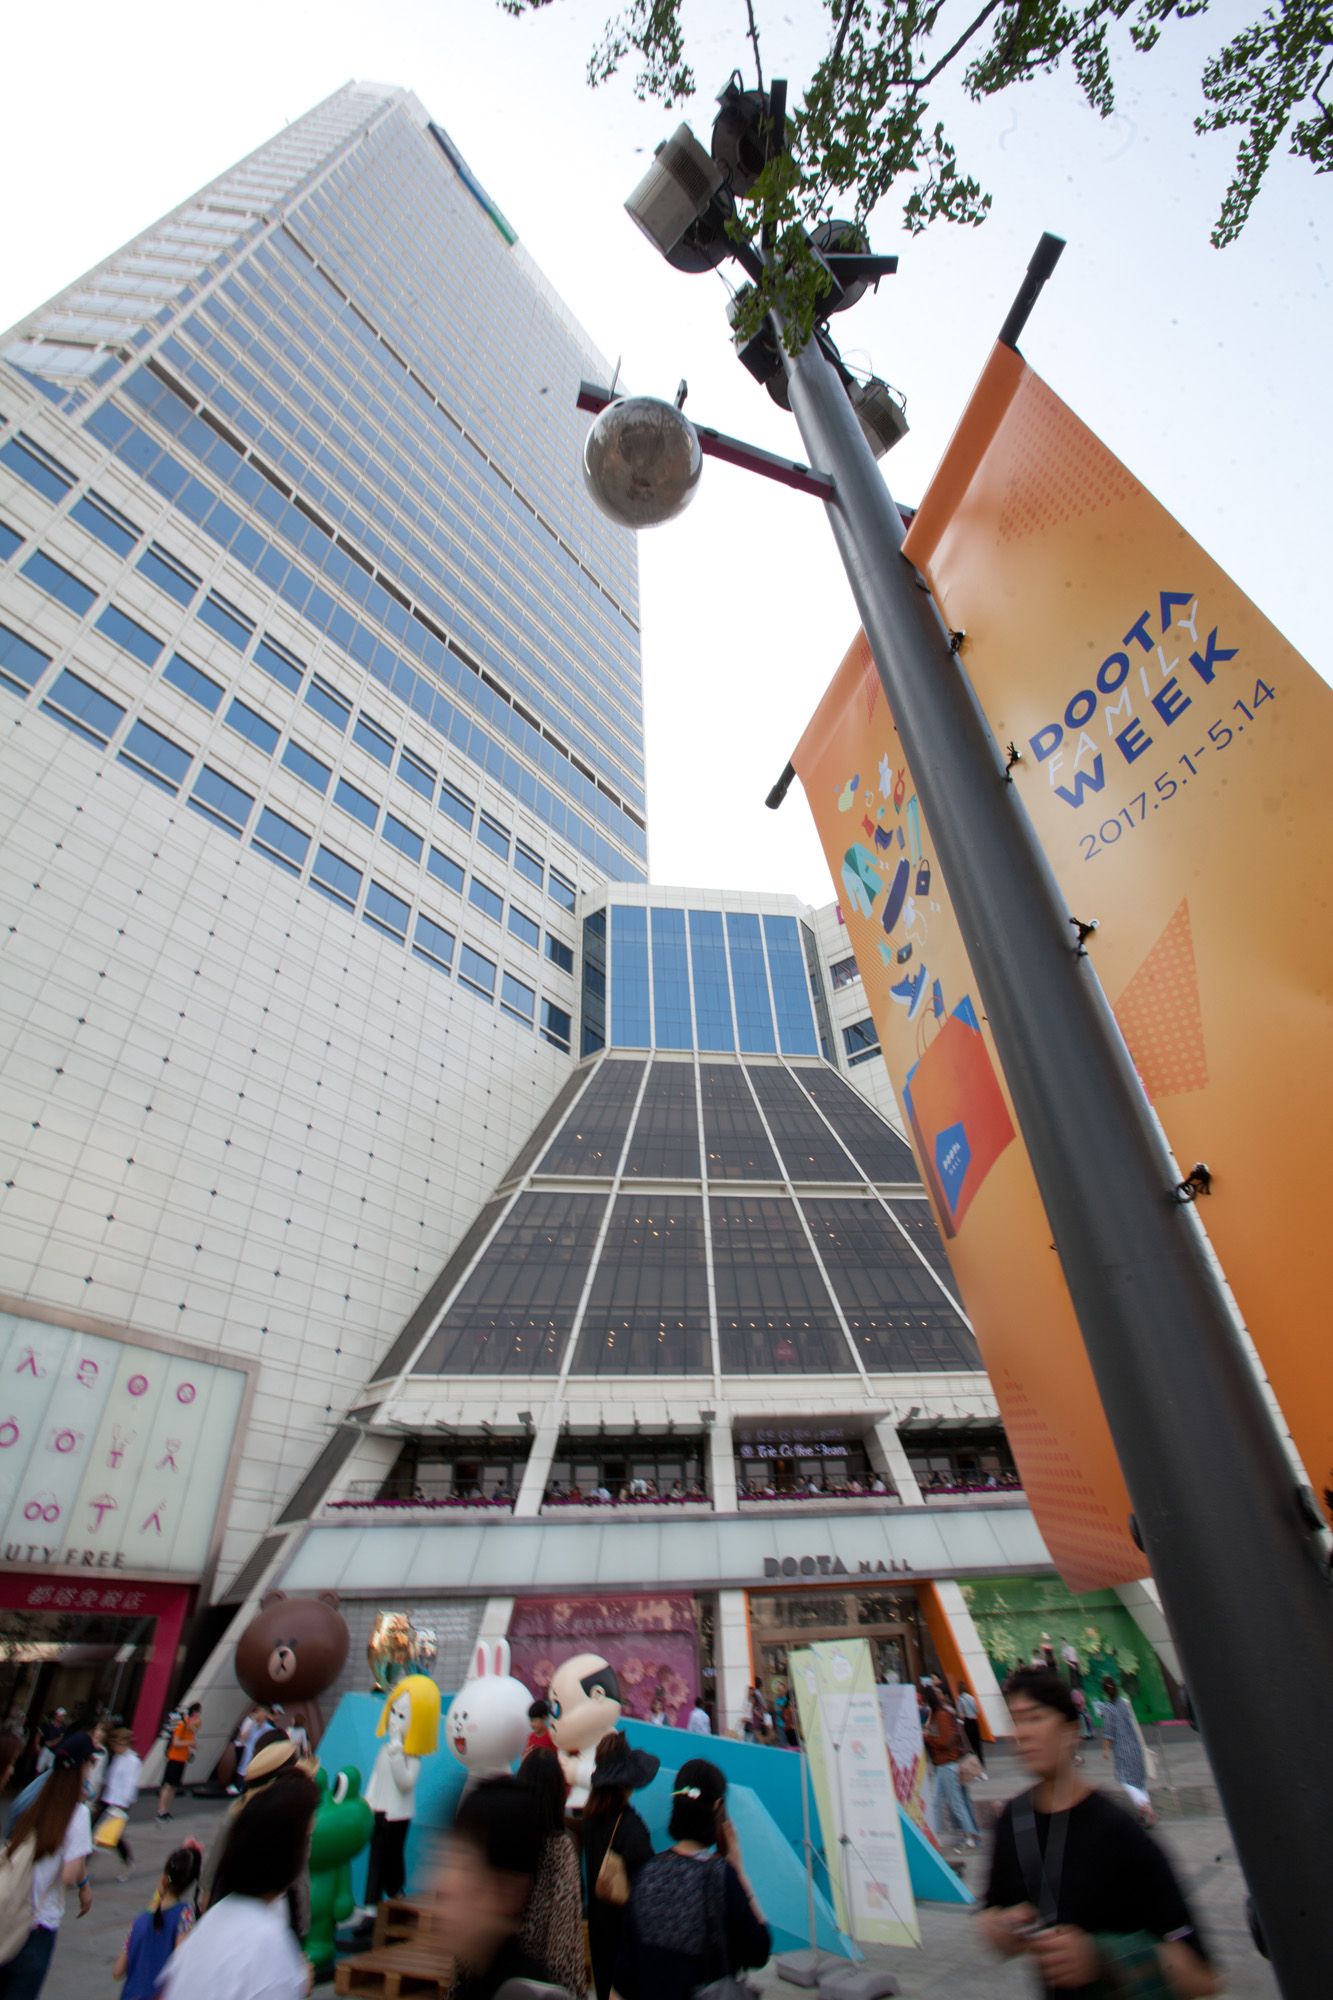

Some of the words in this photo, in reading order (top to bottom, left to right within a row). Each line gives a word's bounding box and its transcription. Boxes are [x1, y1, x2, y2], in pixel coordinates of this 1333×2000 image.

[1028, 591, 1195, 763] DOOTA
[1047, 598, 1199, 786] FAMILY
[1054, 625, 1240, 809] WEEK
[1078, 678, 1276, 861] 2017.5.1-5.14
[64, 1548, 126, 1569] FREE
[763, 1554, 850, 1578] DOOTA
